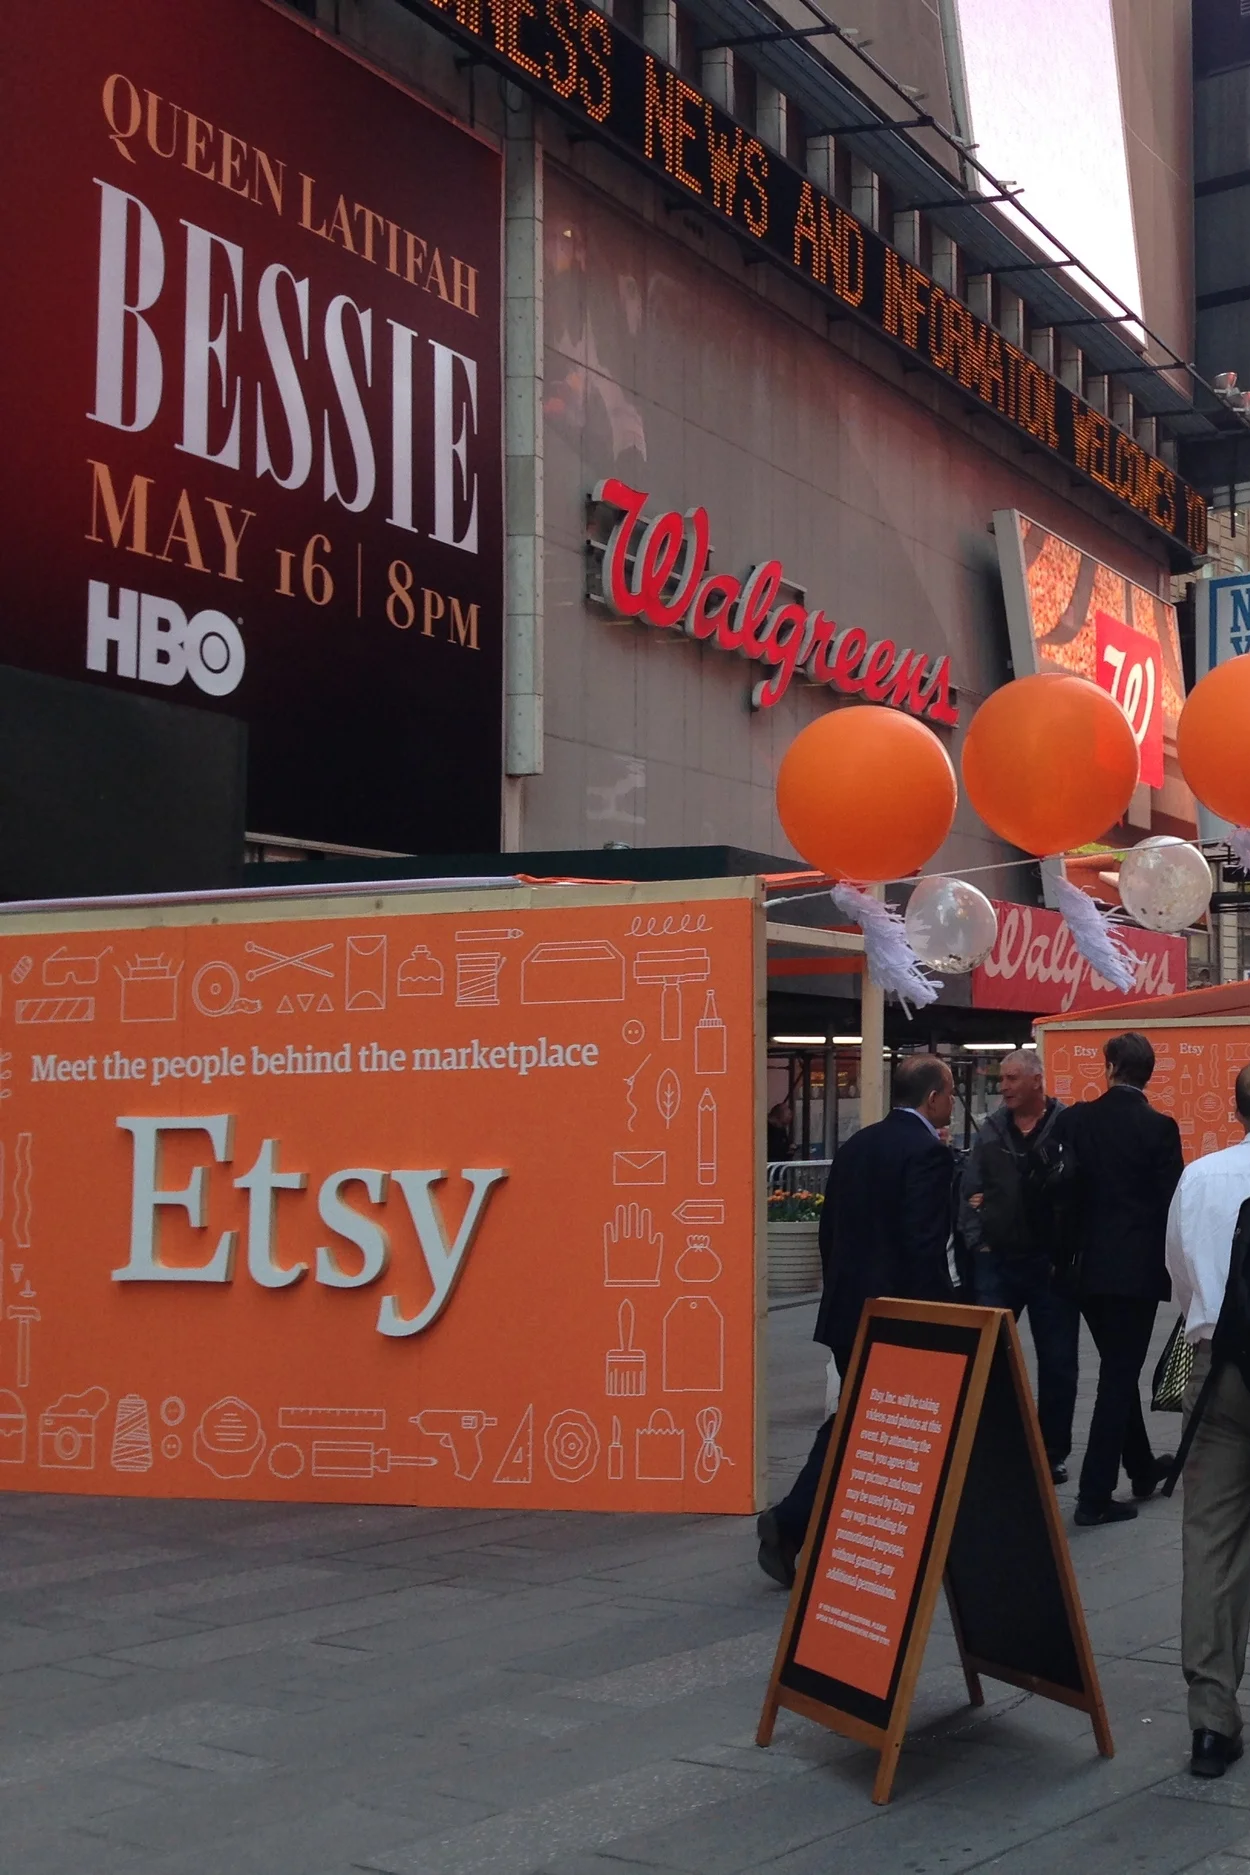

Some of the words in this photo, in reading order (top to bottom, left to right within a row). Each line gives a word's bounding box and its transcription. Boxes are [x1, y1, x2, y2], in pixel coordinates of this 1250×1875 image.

[103, 74, 287, 216] QUEEN
[298, 172, 479, 318] LATIFAH
[645, 56, 767, 238] NEWS
[794, 181, 864, 307] AND
[883, 247, 1060, 449] INFORMATION
[1072, 396, 1176, 536] WELCOMES
[86, 177, 479, 555] BESSIE
[84, 459, 256, 583] MAY
[275, 534, 334, 606] 16
[386, 559, 481, 651] 8PM
[593, 477, 960, 727] Walgreens
[87, 579, 245, 697] HBO
[983, 907, 1176, 1013] Walgns
[30, 1054, 97, 1082] Meet
[102, 1053, 145, 1081] the
[151, 1047, 246, 1085] people
[251, 1044, 352, 1076] behind
[358, 1042, 406, 1072] the
[411, 1037, 599, 1075] marketplace
[1074, 1045, 1098, 1058] Etsy
[1179, 1042, 1204, 1055] Etsy
[111, 1113, 510, 1338] Etsy
[909, 1395, 918, 1408] be
[918, 1398, 939, 1414] taking
[866, 1408, 885, 1422] videos
[885, 1413, 899, 1425] and
[897, 1415, 920, 1429] photos
[920, 1420, 928, 1431] at
[928, 1420, 942, 1433] this
[879, 1431, 888, 1446] By
[888, 1435, 919, 1453] attending
[874, 1453, 887, 1465] you
[886, 1457, 905, 1469] agree
[905, 1458, 919, 1472] that
[850, 1469, 865, 1480] your
[865, 1471, 888, 1486] picture
[887, 1477, 901, 1489] and
[900, 1481, 922, 1494] sound
[846, 1489, 859, 1502] may
[859, 1489, 868, 1502] be
[868, 1494, 884, 1506] used
[883, 1495, 893, 1511] by
[892, 1498, 906, 1515] Etsy
[841, 1508, 853, 1522] any
[866, 1513, 897, 1535] including
[895, 1521, 908, 1535] for
[836, 1528, 874, 1547] promotional
[826, 1567, 858, 1586] additional
[832, 1548, 856, 1563] without
[854, 1556, 882, 1575] granting
[881, 1564, 895, 1578] any
